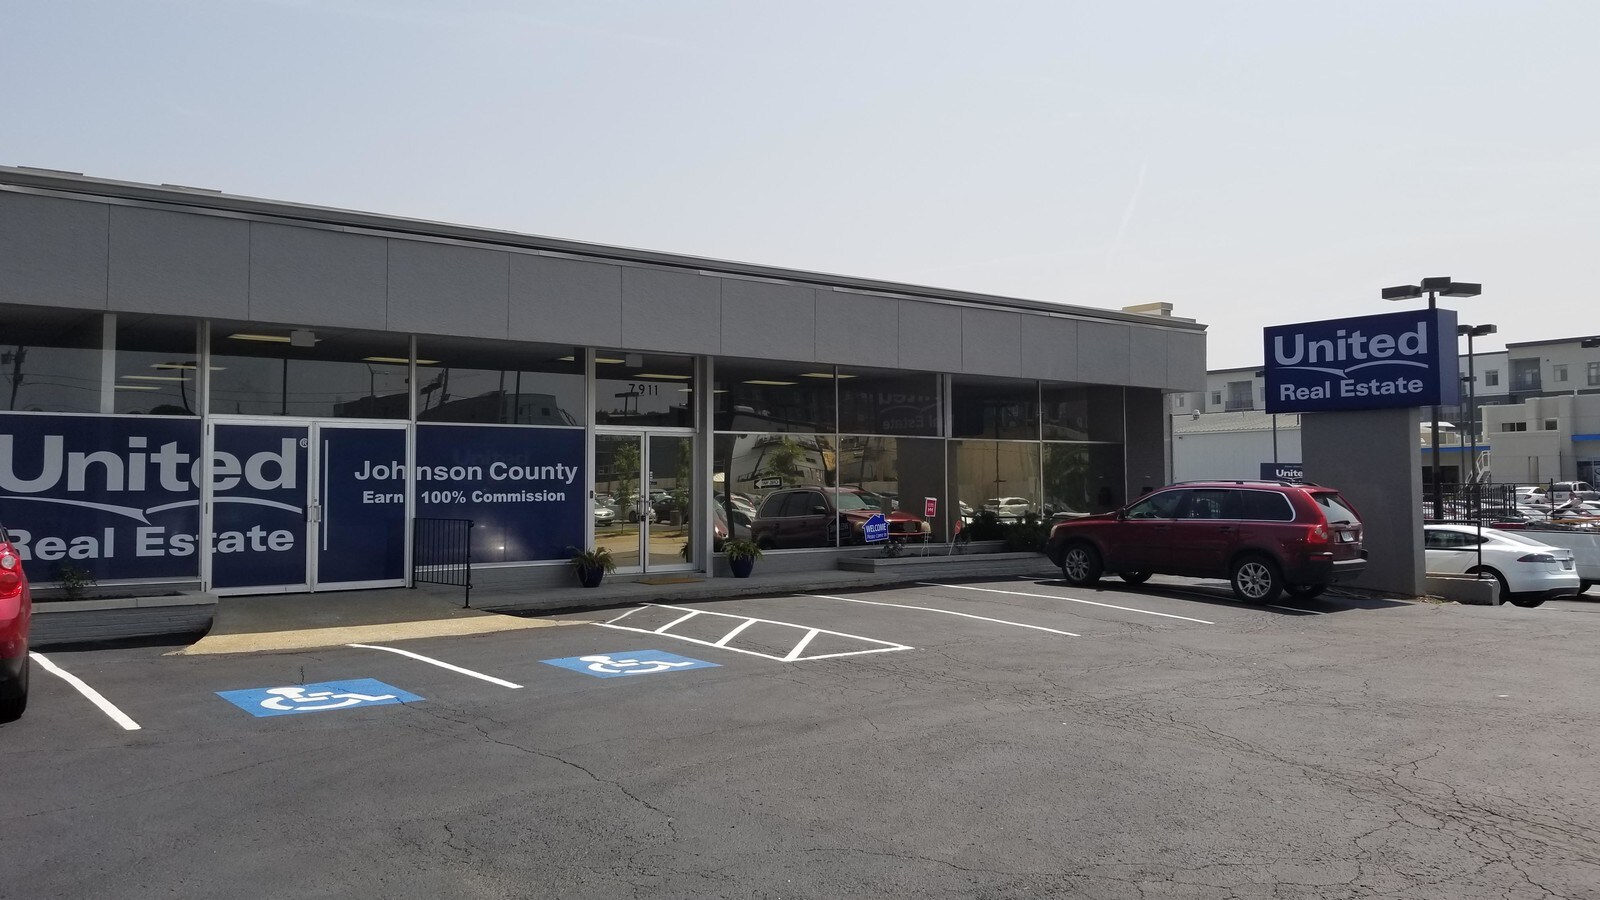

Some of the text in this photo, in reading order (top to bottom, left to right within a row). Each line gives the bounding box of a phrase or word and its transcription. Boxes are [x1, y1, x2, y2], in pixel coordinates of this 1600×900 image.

[1274, 321, 1428, 365] United
[628, 383, 658, 396] 7911
[1280, 376, 1424, 401] Real Estate
[354, 460, 578, 484] Johnson County
[1276, 469, 1303, 477] Unite
[362, 490, 566, 504] Earn 100% Commission
[866, 524, 886, 533] WELCOME
